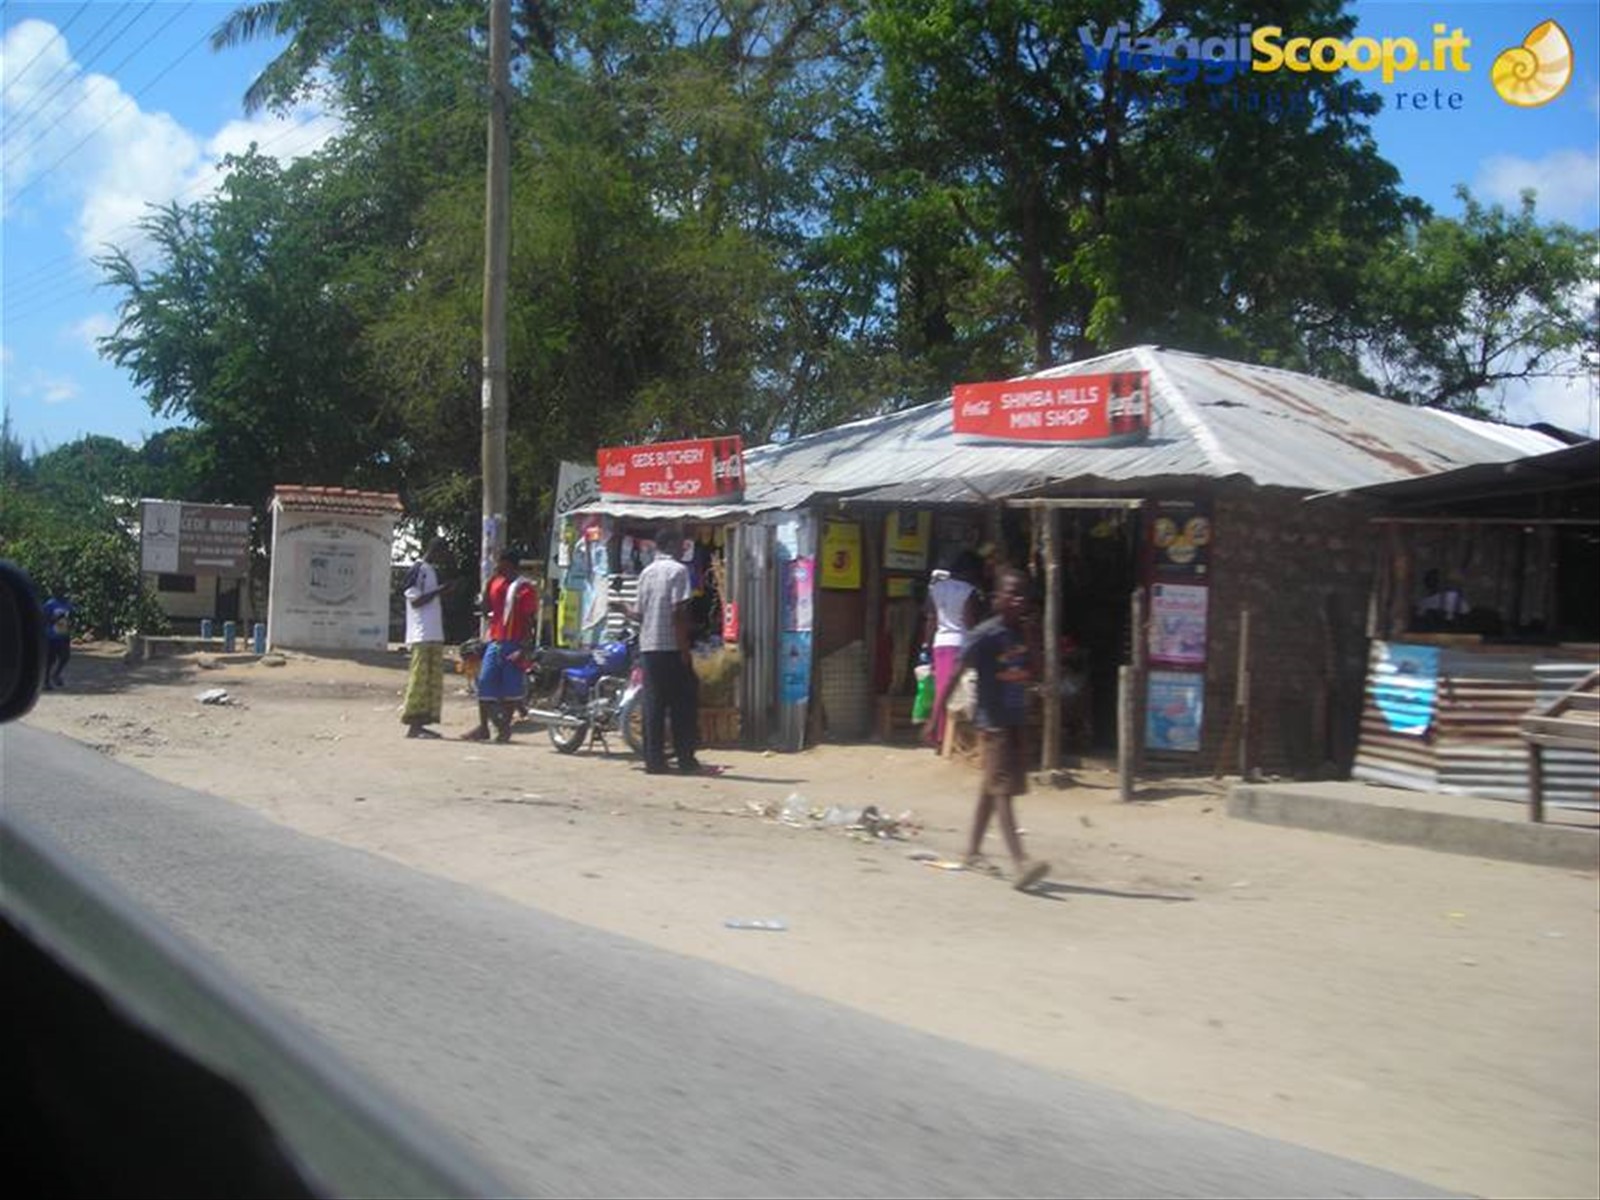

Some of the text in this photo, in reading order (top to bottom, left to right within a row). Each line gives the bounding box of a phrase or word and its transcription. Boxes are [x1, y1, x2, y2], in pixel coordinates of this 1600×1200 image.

[1000, 390, 1054, 410] SHIMBA
[1057, 386, 1099, 405] HILLS
[1010, 408, 1089, 428] MINI SHOP
[655, 448, 704, 467] BUTCHERY
[639, 479, 702, 496] RETAIL SHOP
